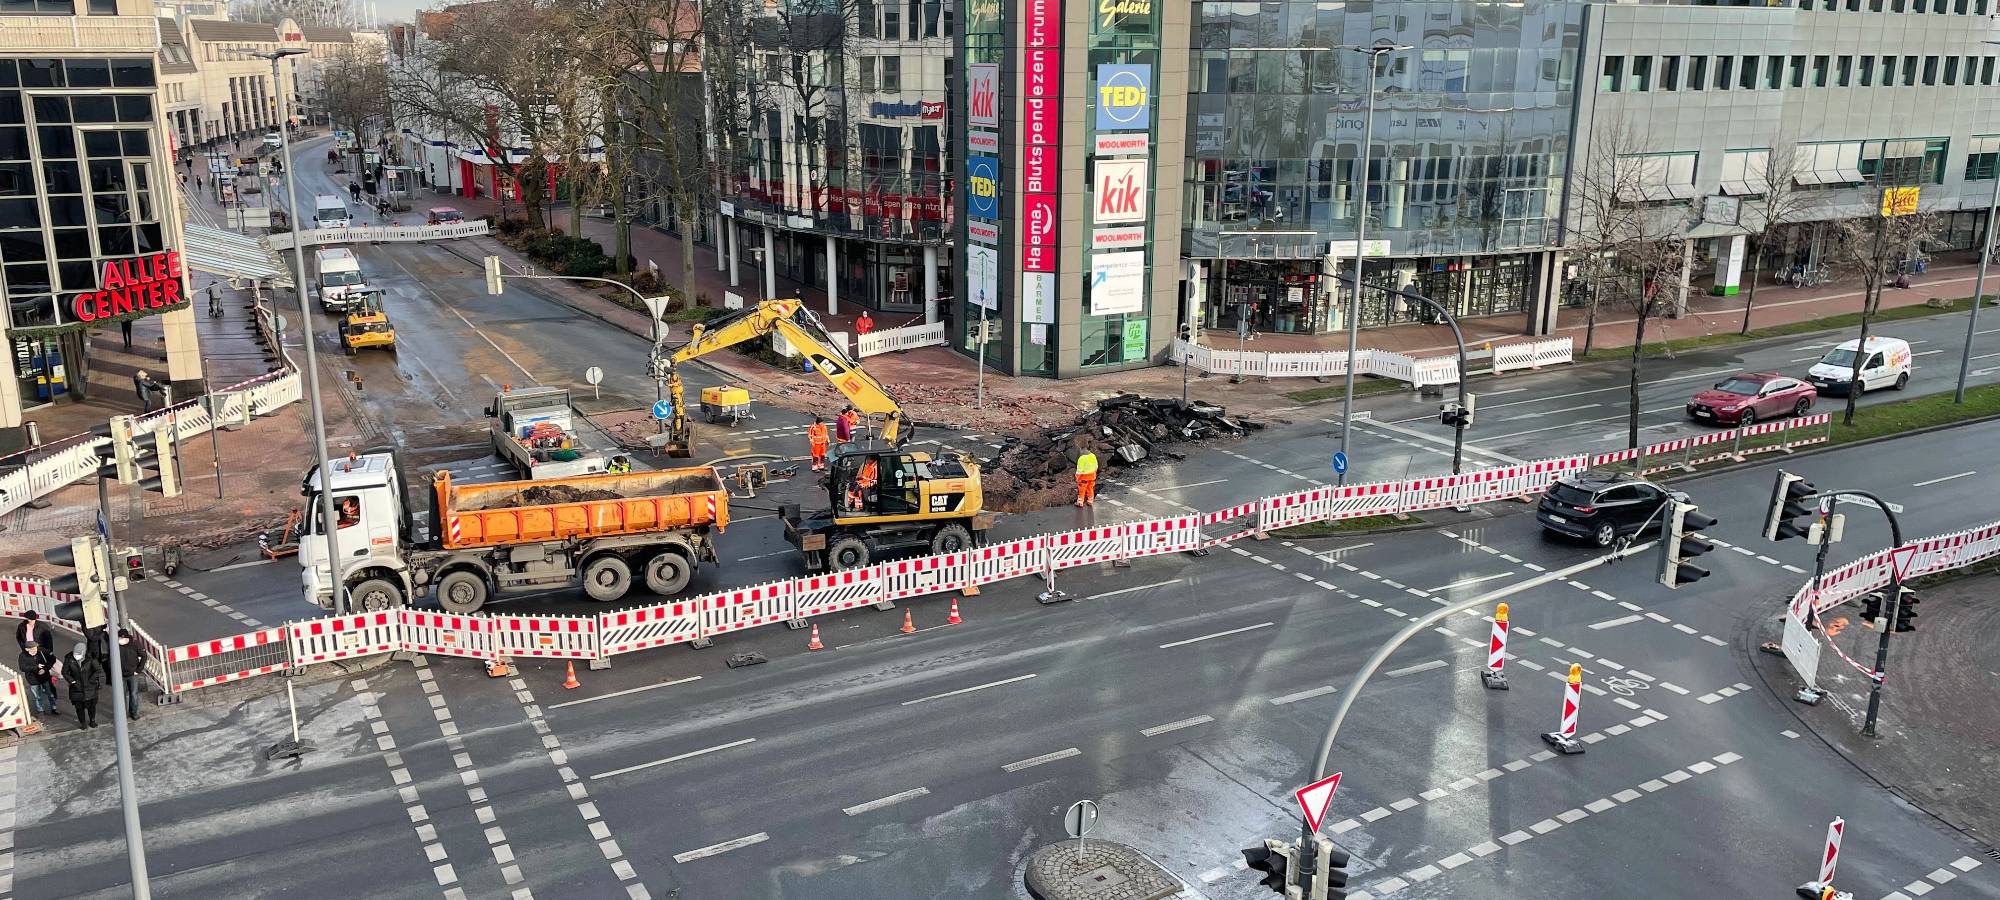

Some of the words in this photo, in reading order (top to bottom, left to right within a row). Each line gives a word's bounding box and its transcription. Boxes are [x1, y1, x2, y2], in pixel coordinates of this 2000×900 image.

[1100, 0, 1151, 28] Galerie
[1028, 0, 1046, 192] Blutspendezentrum
[1100, 85, 1147, 107] TEDi
[1098, 139, 1146, 149] WOOLWORTH
[971, 175, 996, 198] TEDi
[1100, 167, 1141, 214] kik
[1095, 233, 1142, 243] WOOLWORTH
[104, 252, 182, 290] ALLEE
[76, 279, 180, 322] CENTER
[1035, 274, 1043, 322] BARMER
[820, 358, 837, 375] CAT
[931, 495, 949, 507] CAT
